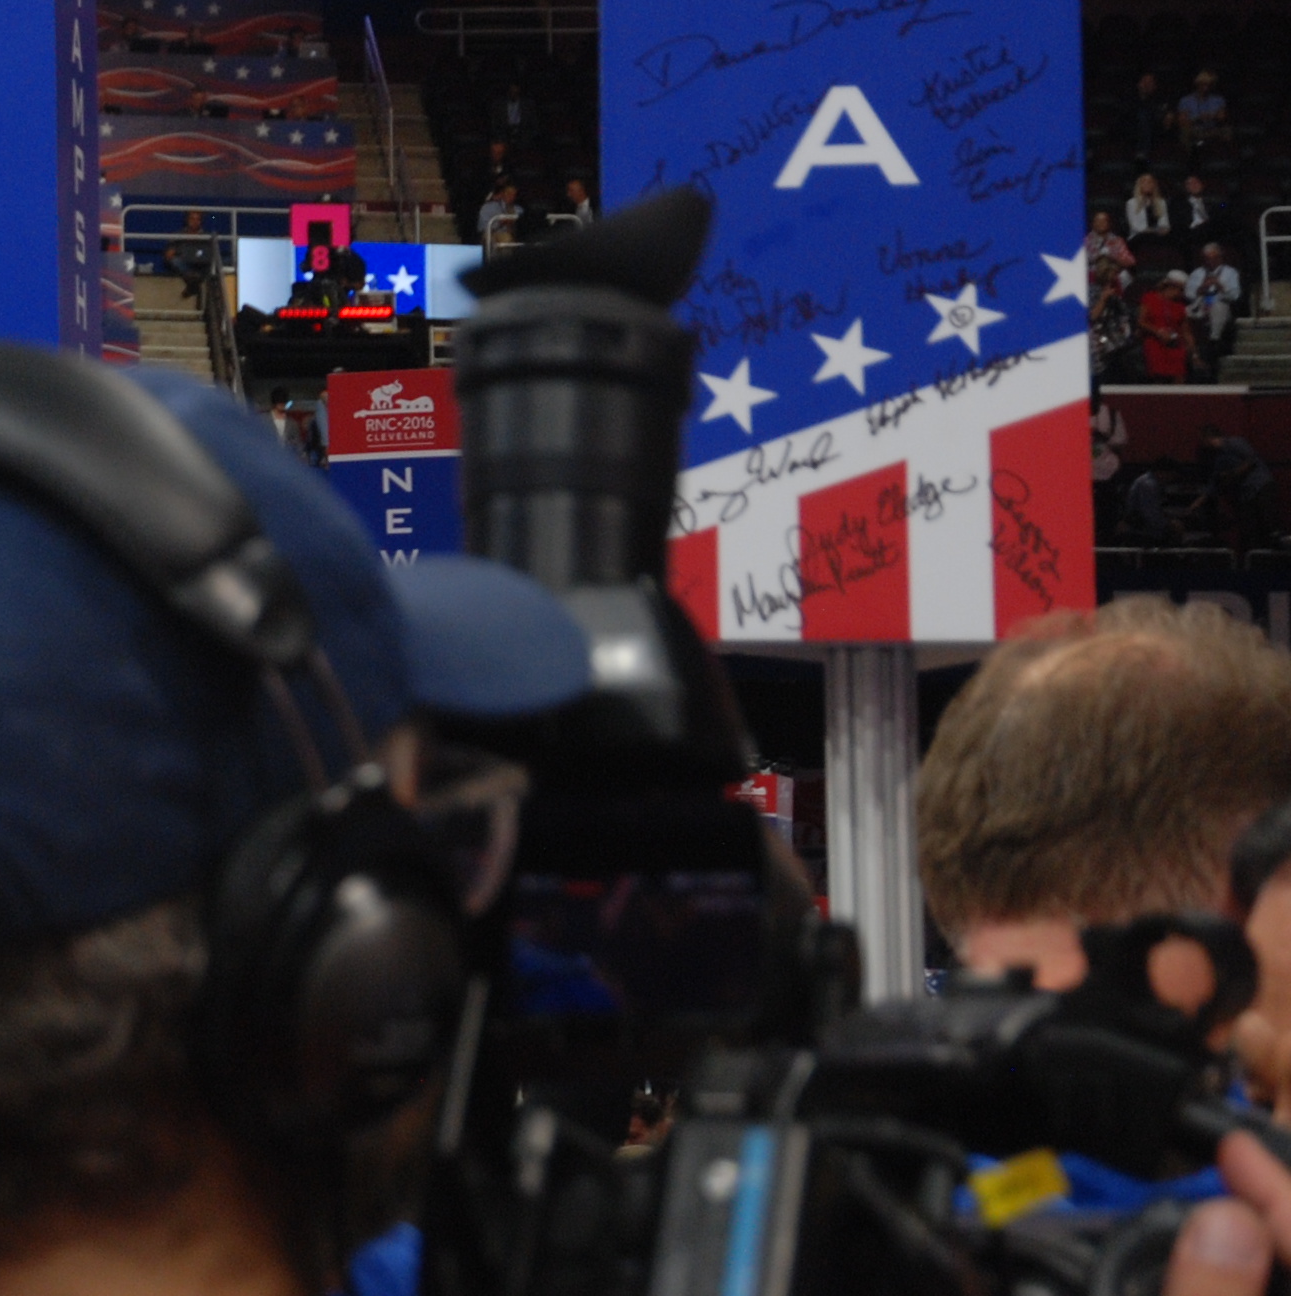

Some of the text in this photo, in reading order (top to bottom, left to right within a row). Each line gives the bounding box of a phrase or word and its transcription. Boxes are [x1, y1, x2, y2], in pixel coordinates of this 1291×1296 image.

[365, 415, 435, 433] RNC 2016
[365, 431, 436, 443] CLEVELAND
[381, 467, 419, 567] NEW
